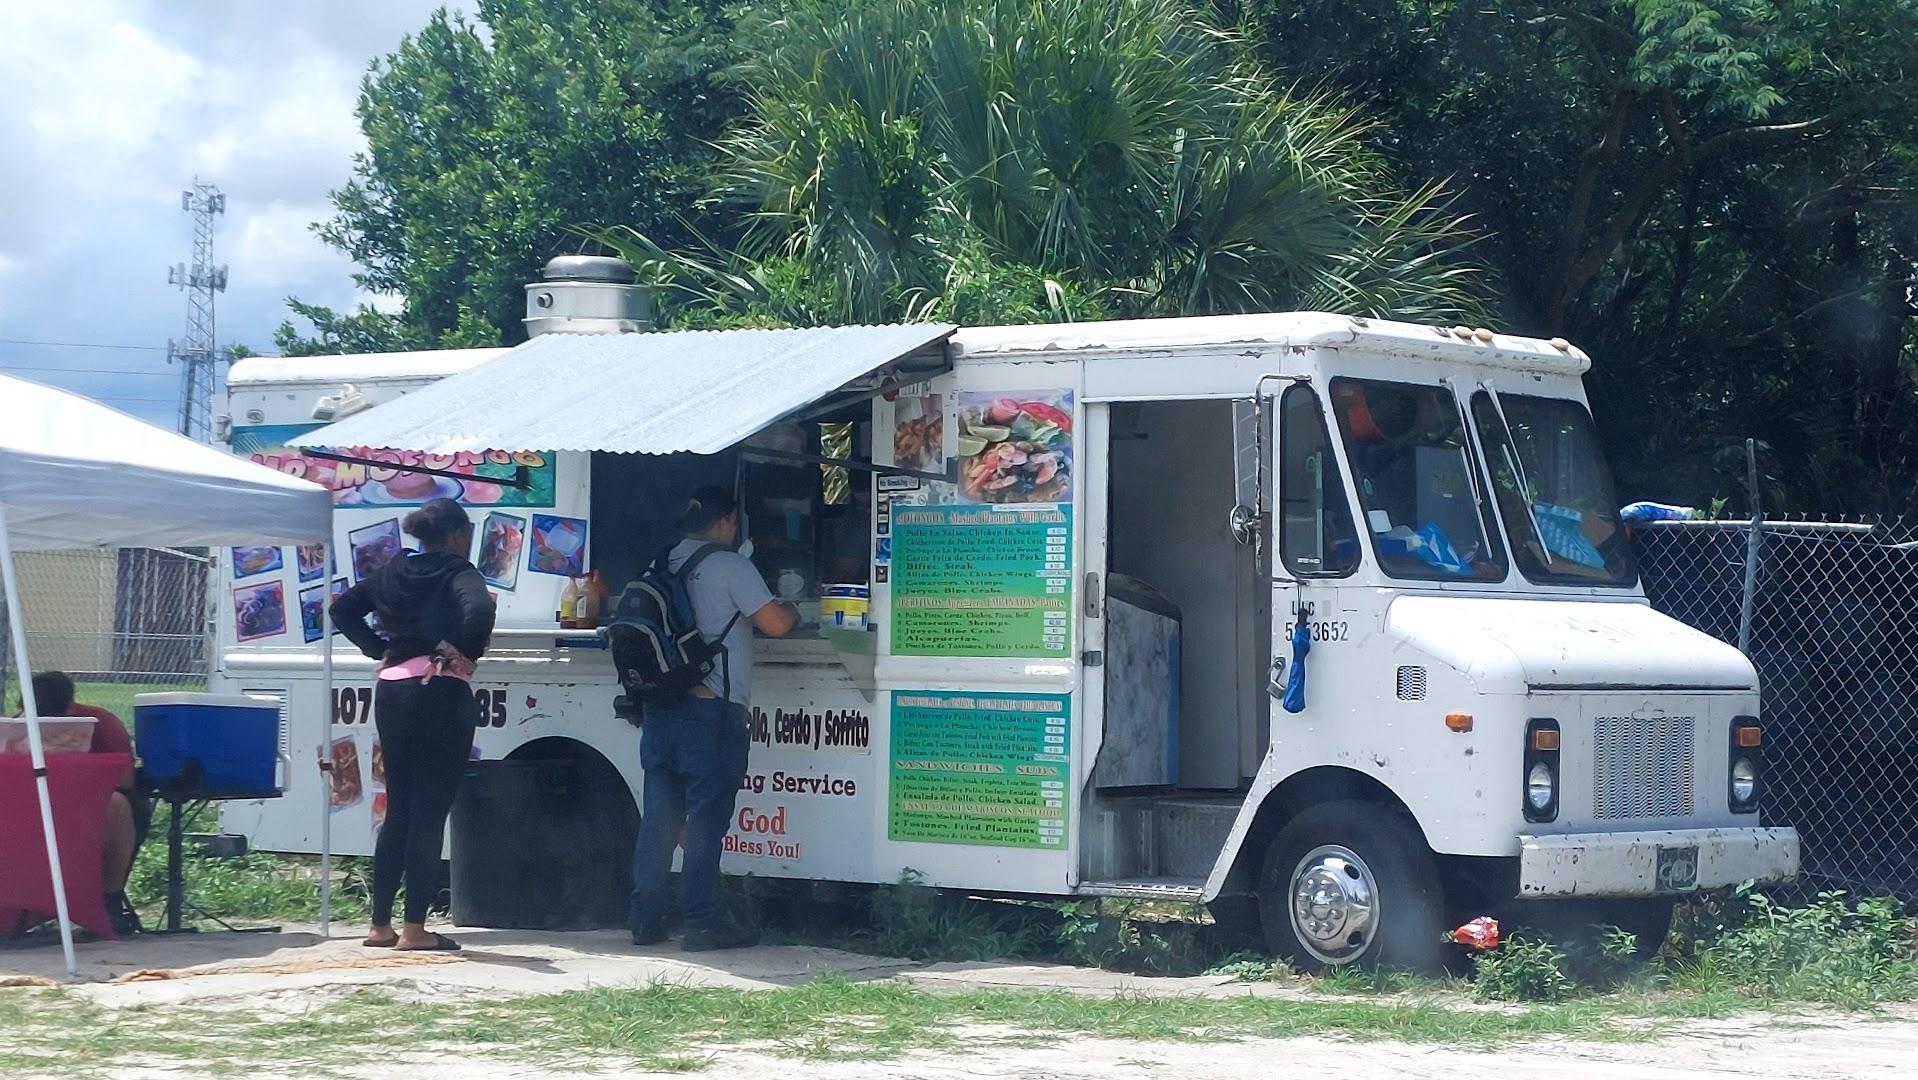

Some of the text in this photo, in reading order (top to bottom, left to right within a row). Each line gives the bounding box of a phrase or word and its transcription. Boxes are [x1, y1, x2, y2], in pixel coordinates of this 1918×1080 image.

[1285, 622, 1348, 641] 53652
[774, 708, 811, 745] Cerdo
[814, 714, 822, 750] y
[825, 709, 869, 748] Sofrito
[772, 771, 856, 796] Service
[738, 806, 786, 834] God
[724, 836, 800, 859] Bless You!
